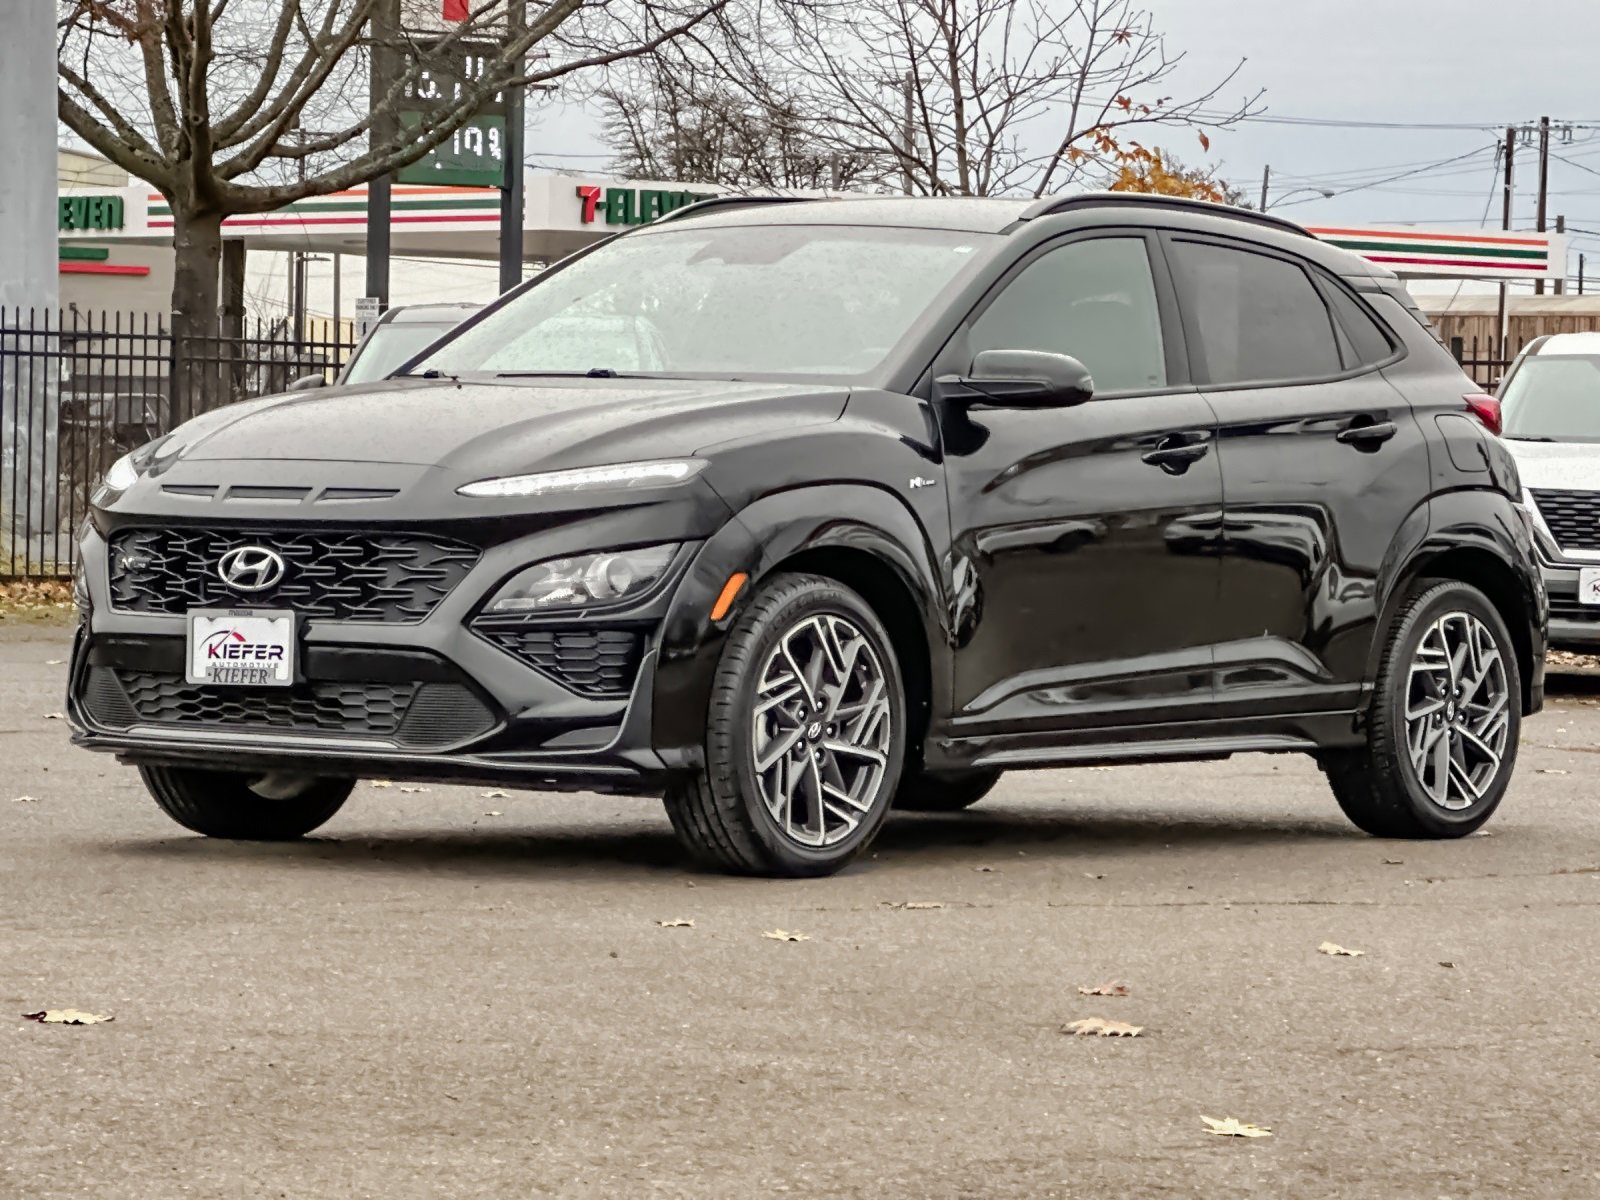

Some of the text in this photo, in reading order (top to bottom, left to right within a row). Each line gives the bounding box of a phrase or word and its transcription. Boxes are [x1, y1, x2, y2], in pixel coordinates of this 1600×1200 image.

[576, 186, 719, 225] 7-ELEV
[208, 643, 284, 660] KIEFER
[211, 661, 279, 669] AUTOMOTIVE
[212, 667, 268, 684] KIEFER
